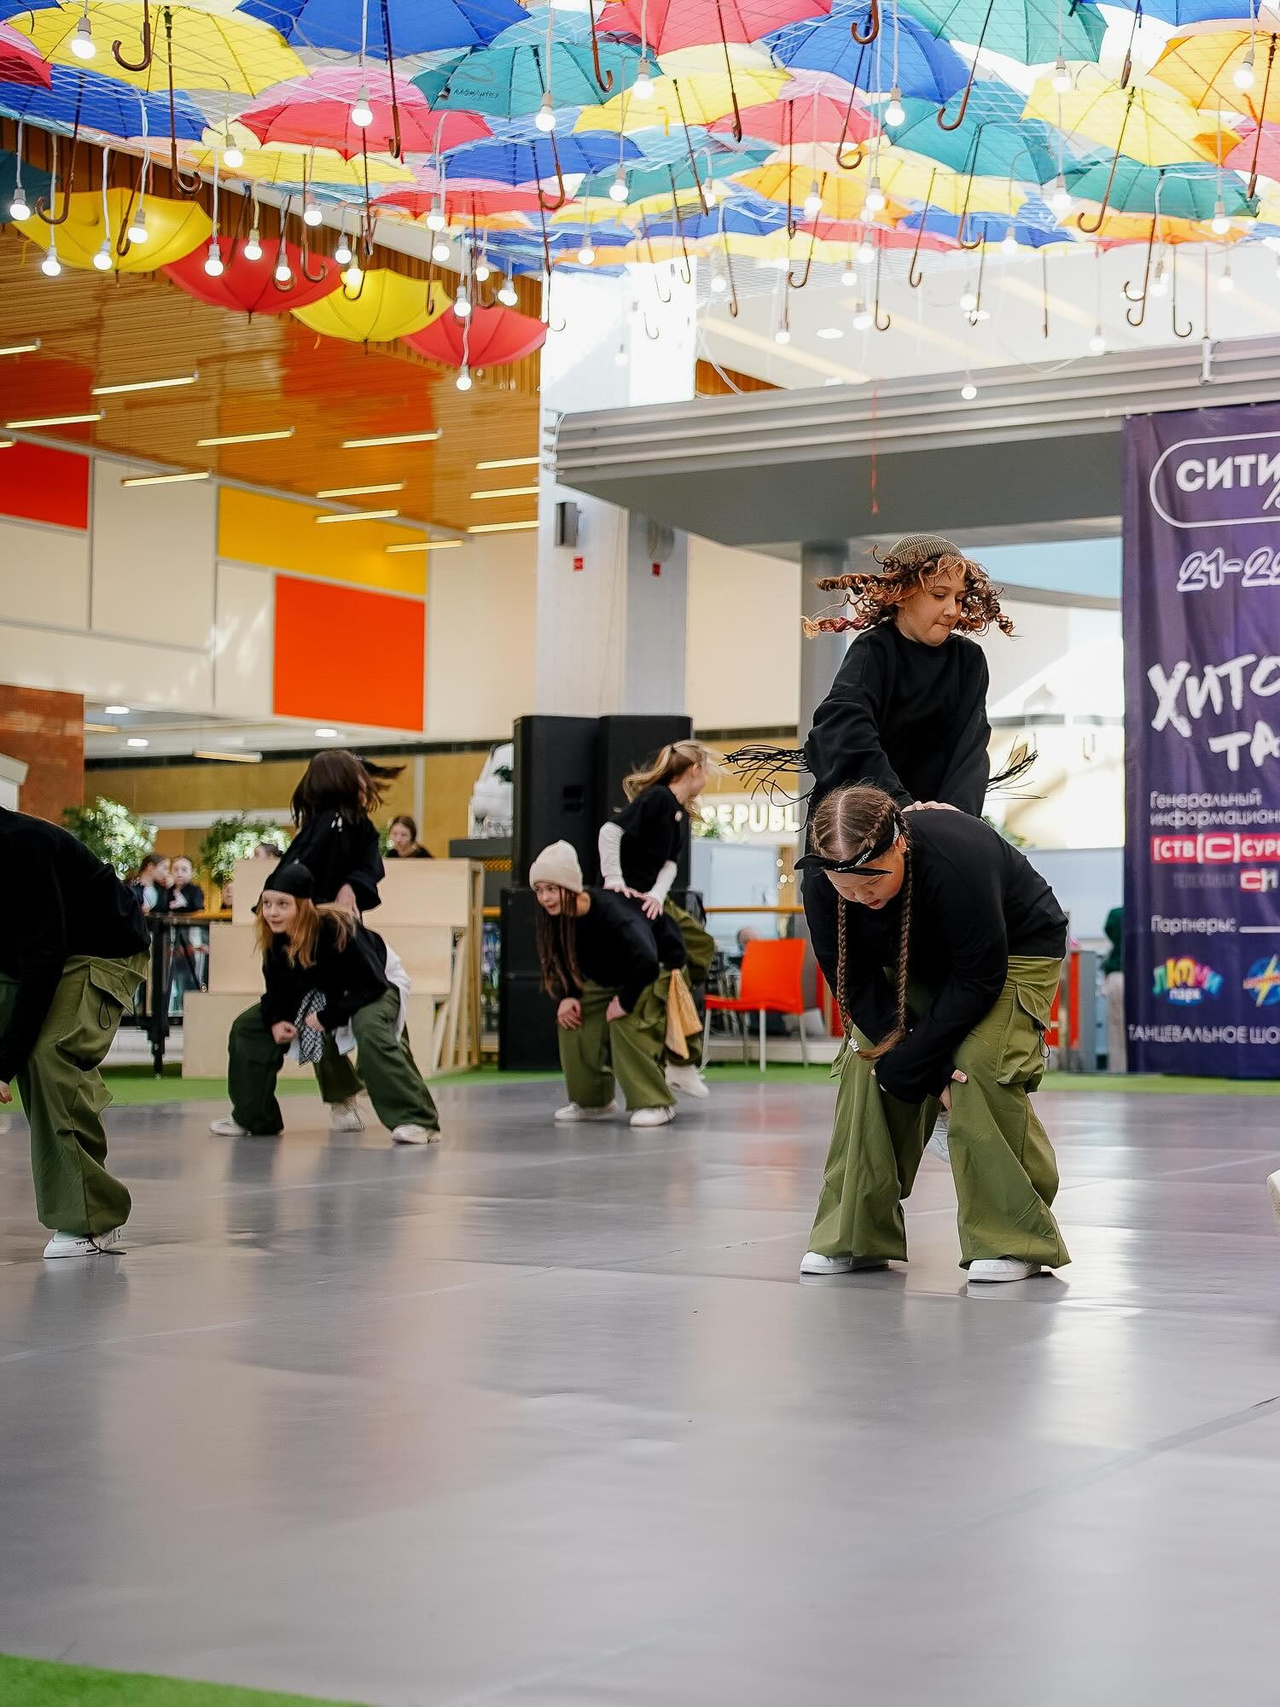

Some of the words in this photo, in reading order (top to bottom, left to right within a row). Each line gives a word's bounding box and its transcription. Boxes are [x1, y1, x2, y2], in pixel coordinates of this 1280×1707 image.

[1150, 788, 1263, 810] Генеральный
[1150, 915, 1237, 936] Партнеры:
[1127, 1024, 1248, 1044] ТАНЦЕВАЛЬНОЕ
